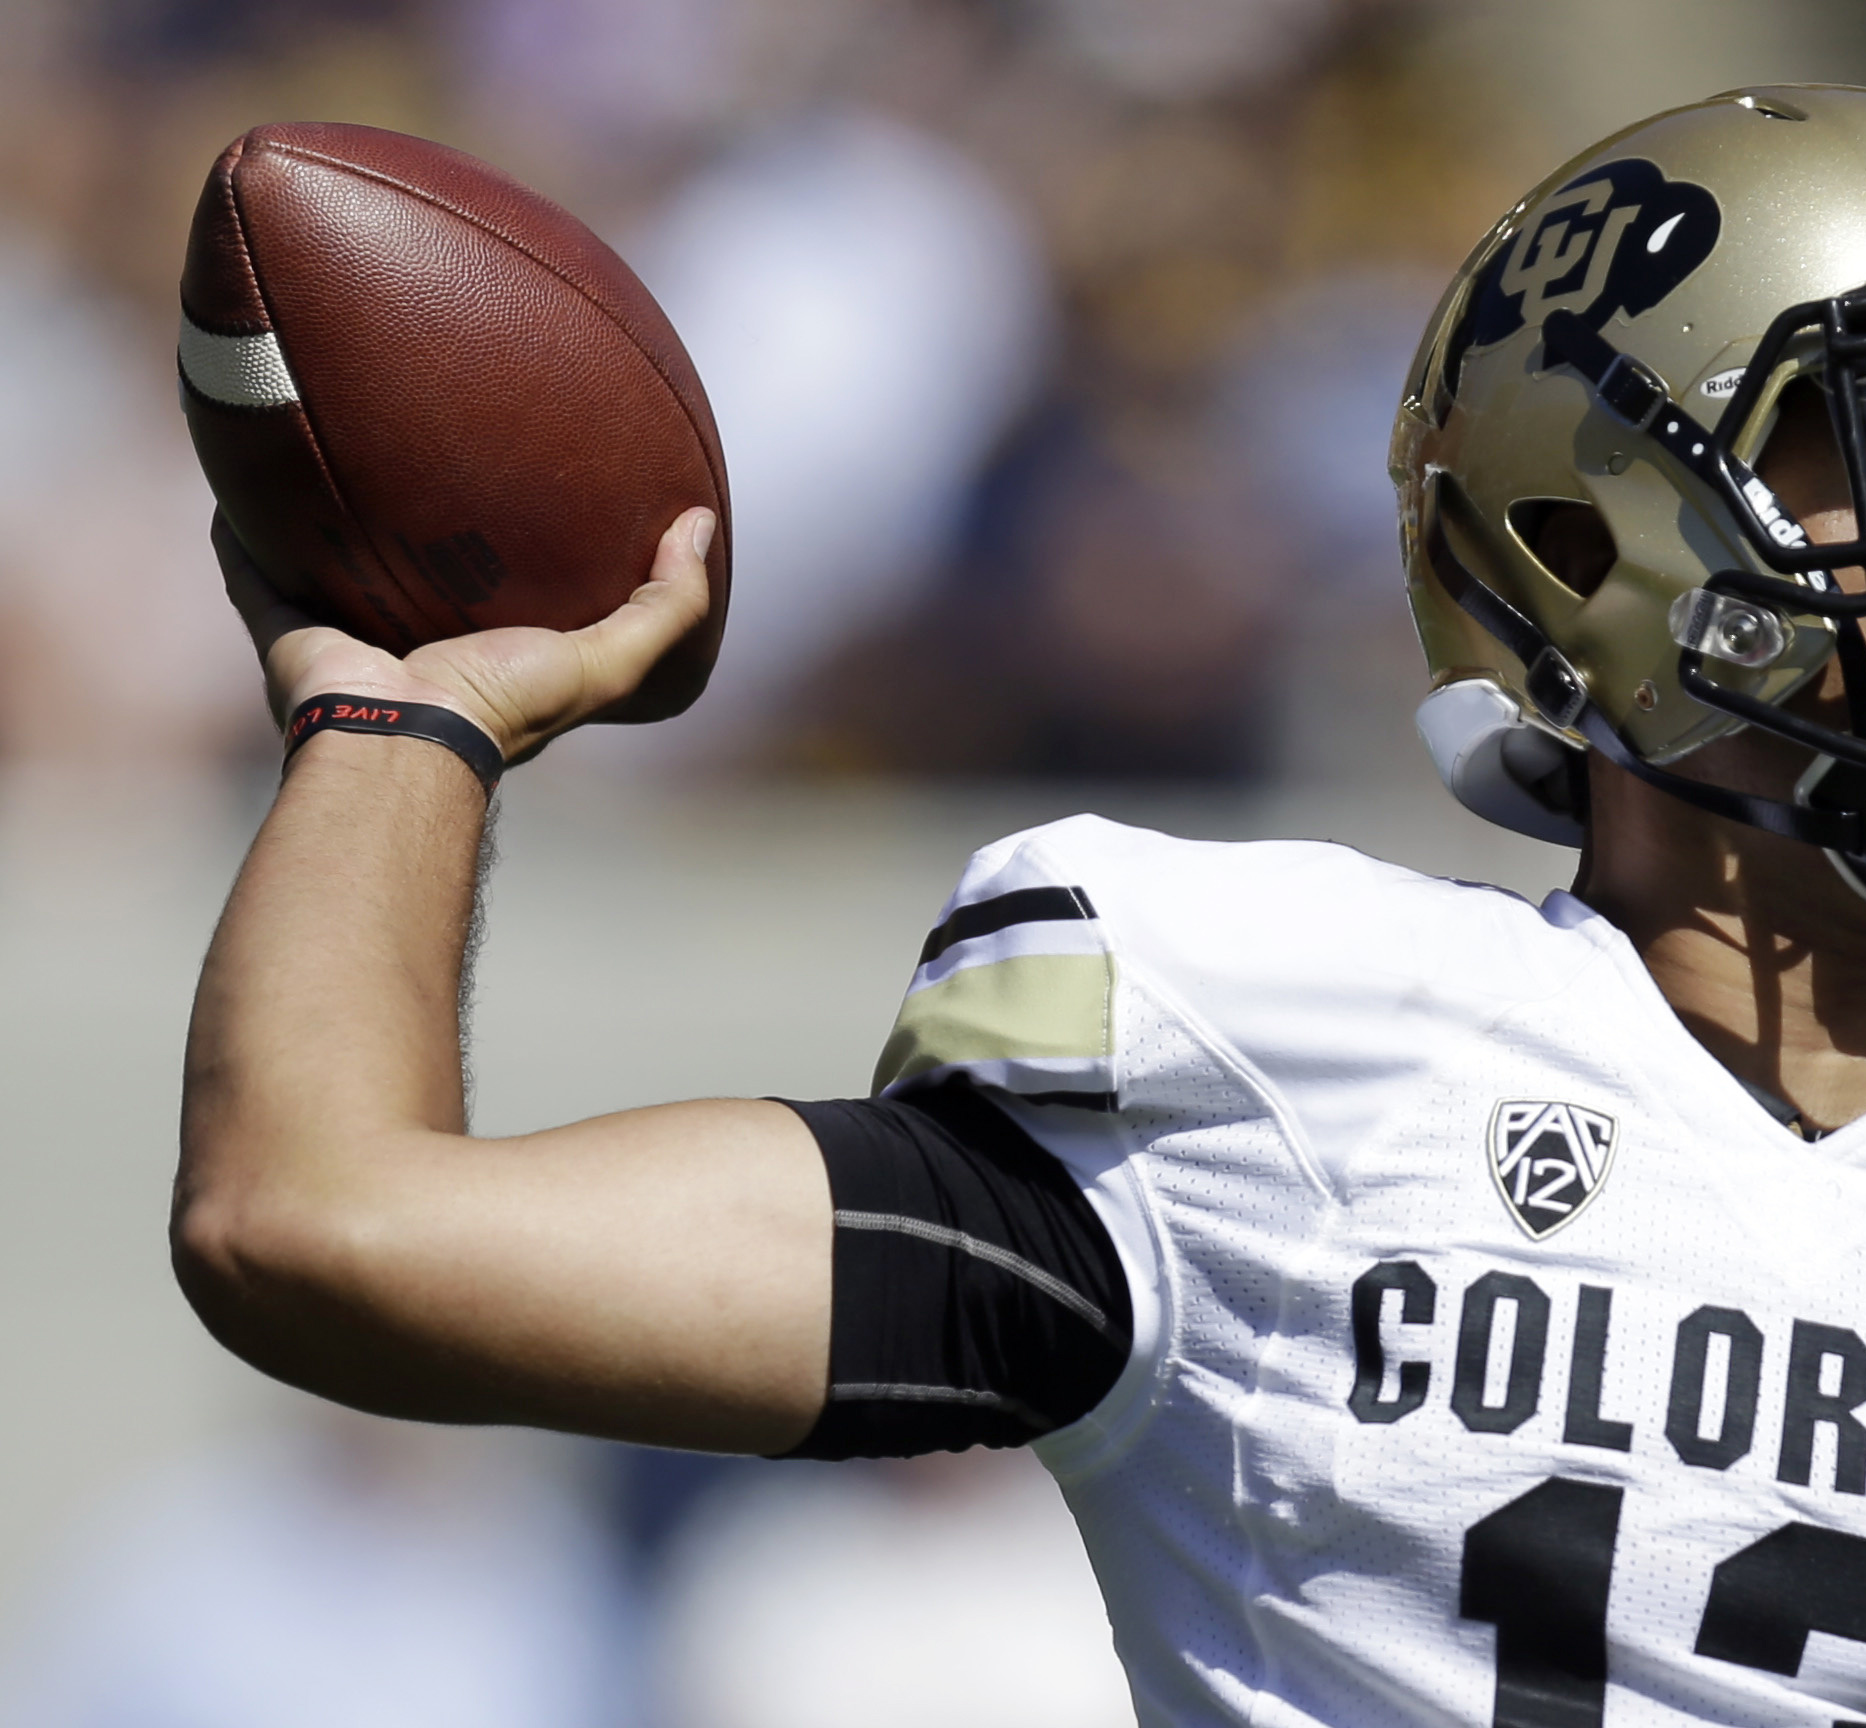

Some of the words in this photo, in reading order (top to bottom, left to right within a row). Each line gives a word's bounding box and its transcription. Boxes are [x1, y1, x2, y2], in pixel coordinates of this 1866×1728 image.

[331, 705, 400, 723] LIVE
[1496, 1102, 1612, 1192] PAC
[1514, 1156, 1577, 1213] 12
